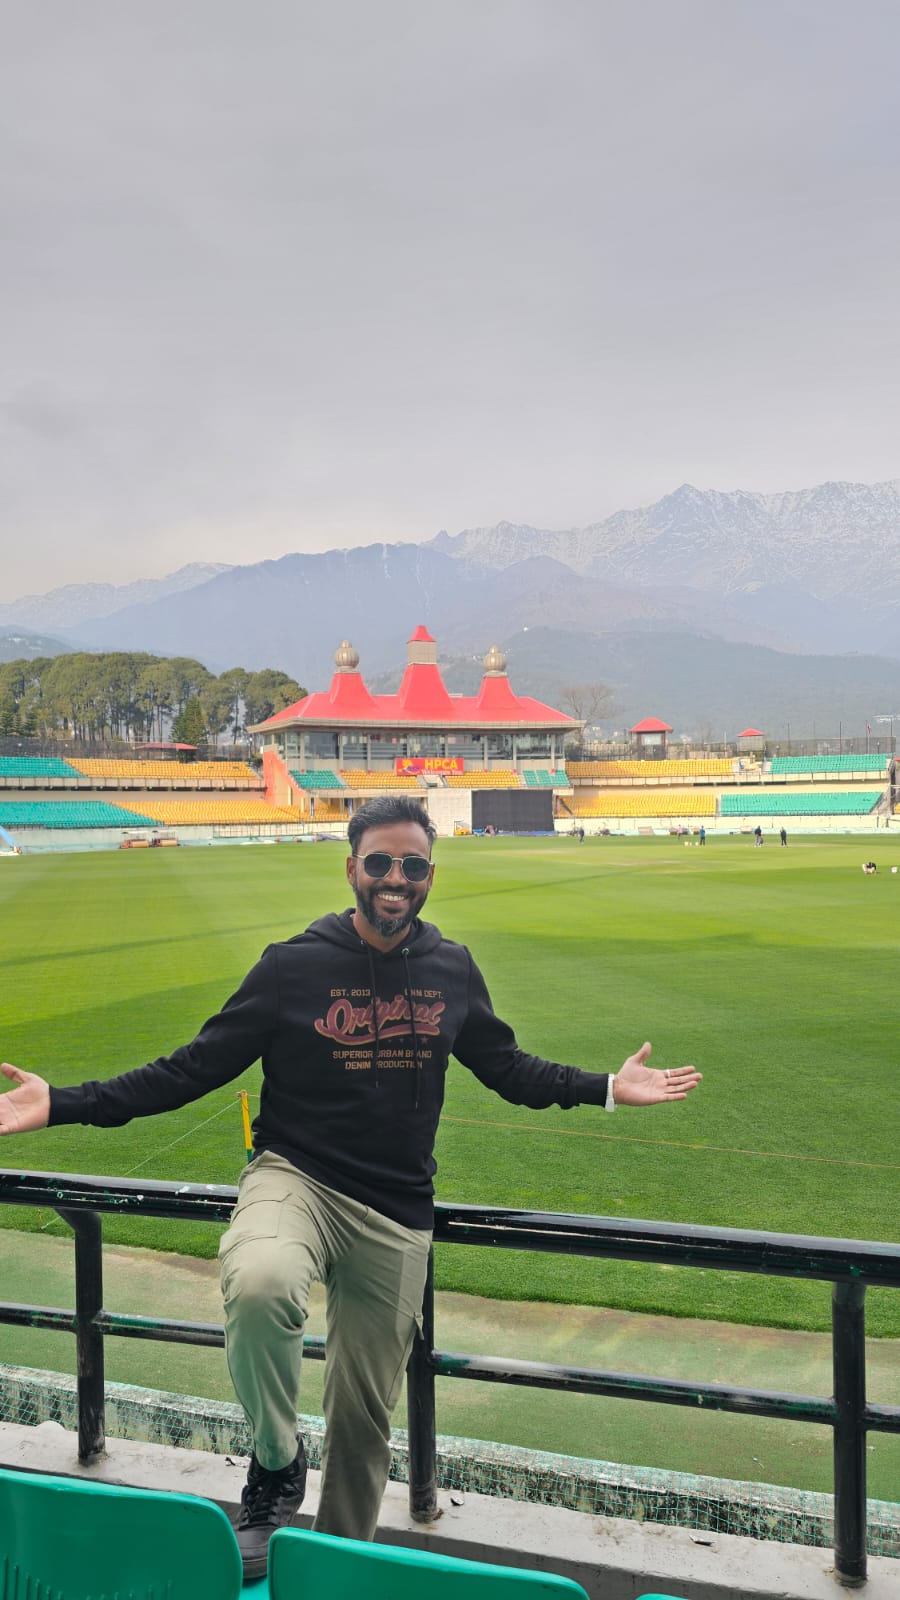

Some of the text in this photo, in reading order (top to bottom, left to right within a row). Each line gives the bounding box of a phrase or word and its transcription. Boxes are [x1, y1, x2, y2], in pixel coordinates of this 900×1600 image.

[425, 759, 458, 769] HPCA
[330, 989, 371, 997] EST. 2013
[422, 990, 444, 999] DEPT.
[314, 995, 446, 1045] Original
[332, 1050, 373, 1059] SUPERIOR
[345, 1061, 371, 1070] DENIM
